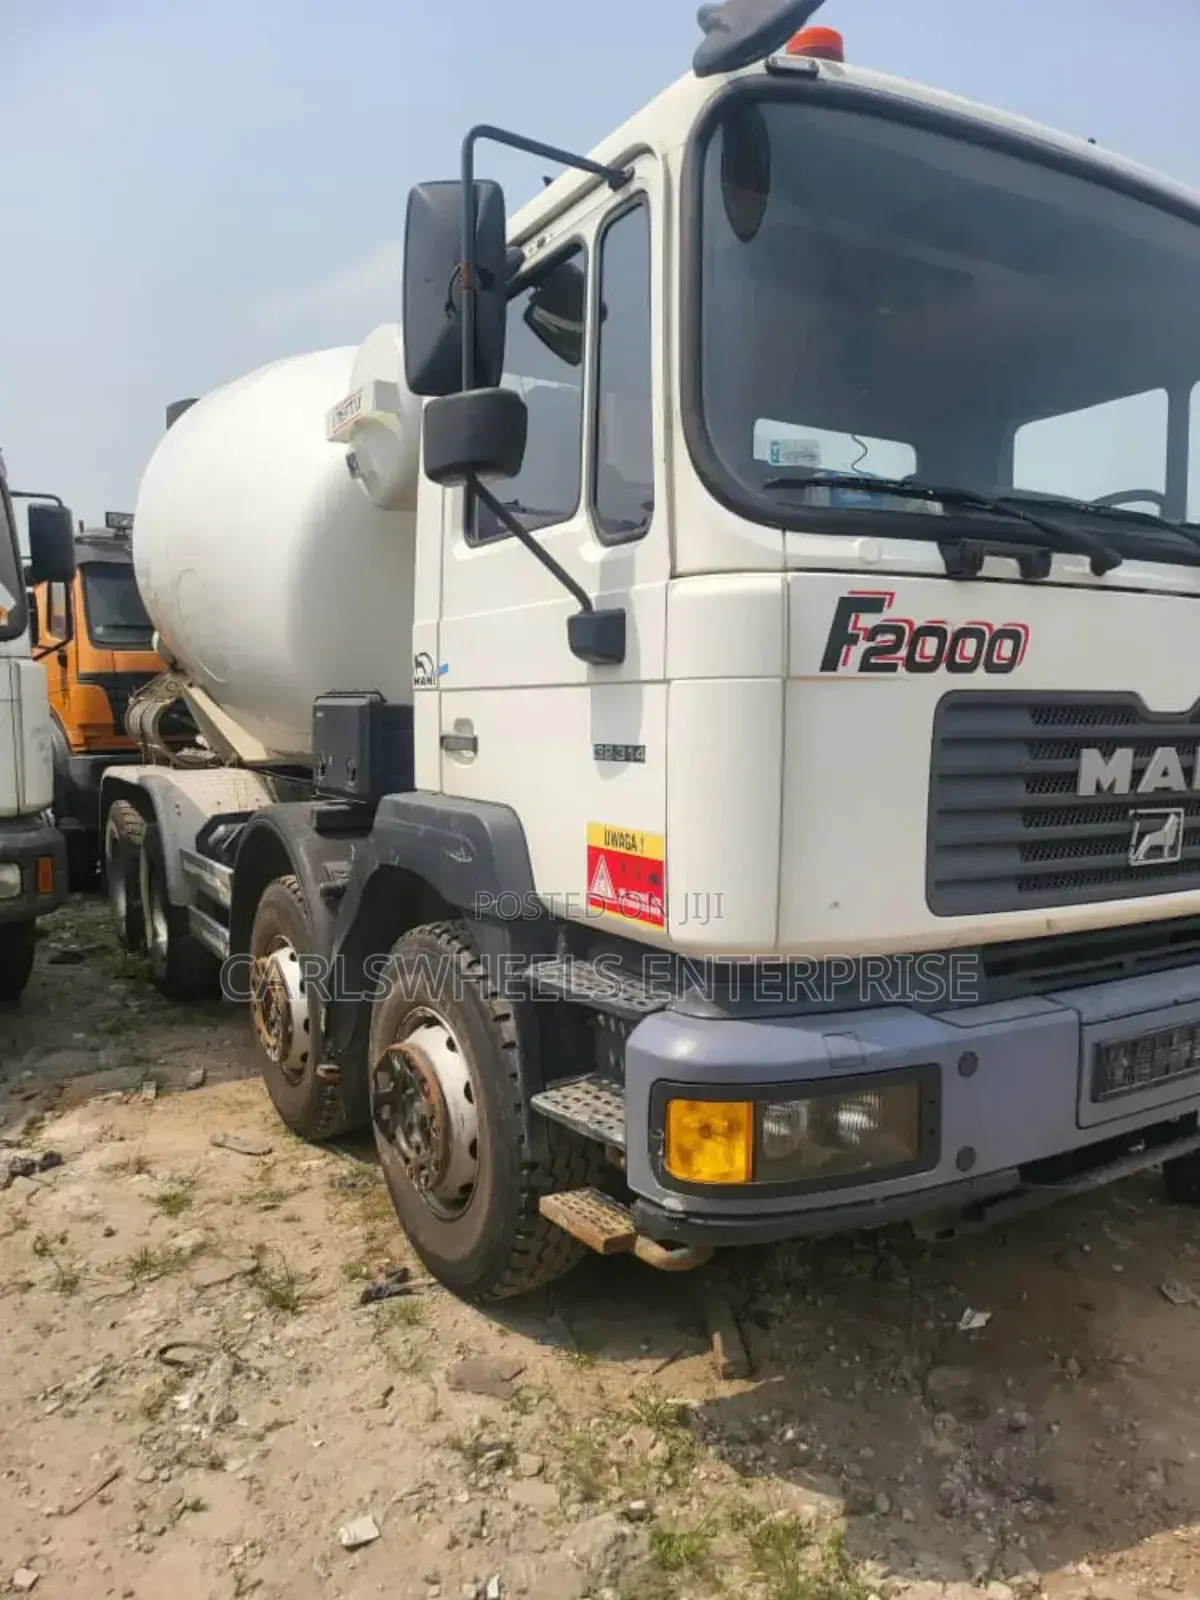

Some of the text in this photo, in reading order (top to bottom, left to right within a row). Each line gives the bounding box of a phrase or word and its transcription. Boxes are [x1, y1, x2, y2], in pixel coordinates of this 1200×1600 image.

[819, 590, 1030, 675] F2000
[1077, 746, 1200, 796] MA
[604, 825, 638, 853] UWAGA
